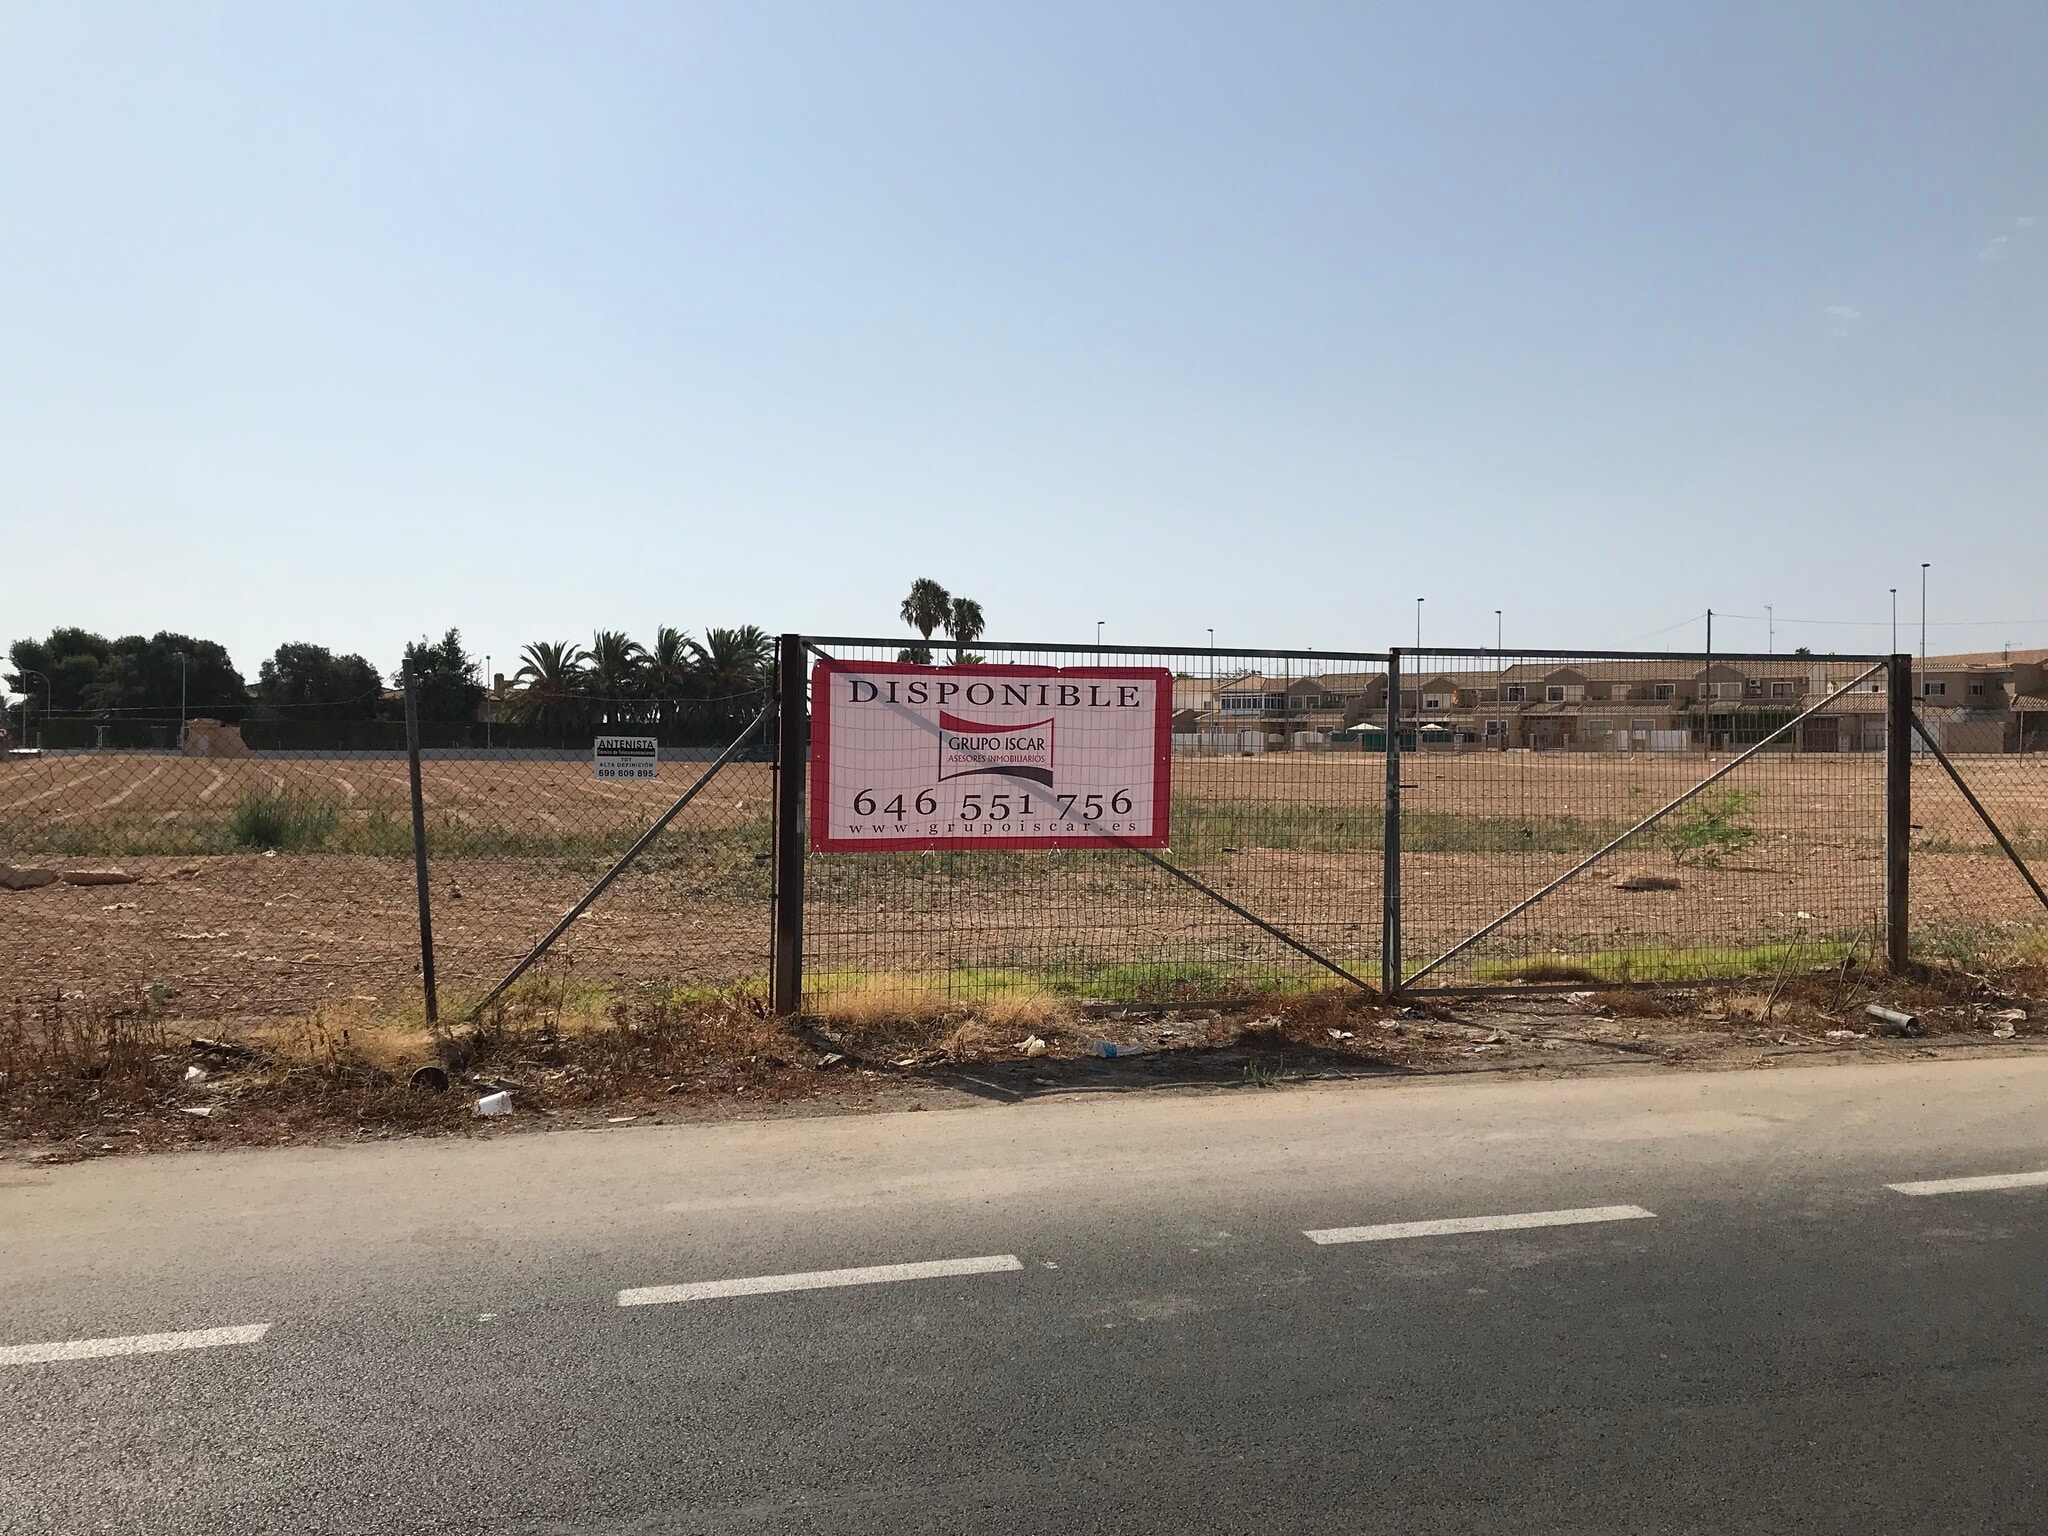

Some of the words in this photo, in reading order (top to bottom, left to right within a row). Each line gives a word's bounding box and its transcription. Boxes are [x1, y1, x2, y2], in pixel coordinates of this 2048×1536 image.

[848, 680, 1140, 708] DISPONIBLE
[598, 740, 654, 749] ANTENISTA
[948, 737, 1000, 751] GRUPO
[1005, 737, 1046, 751] ISCAR
[948, 754, 986, 763] ASESORES
[988, 754, 1046, 763] INMOBILIARIOS
[853, 788, 937, 821] 646
[960, 794, 1034, 821] 551
[1056, 788, 1133, 821] 756
[849, 820, 1137, 834] www.grupoiscar.es
